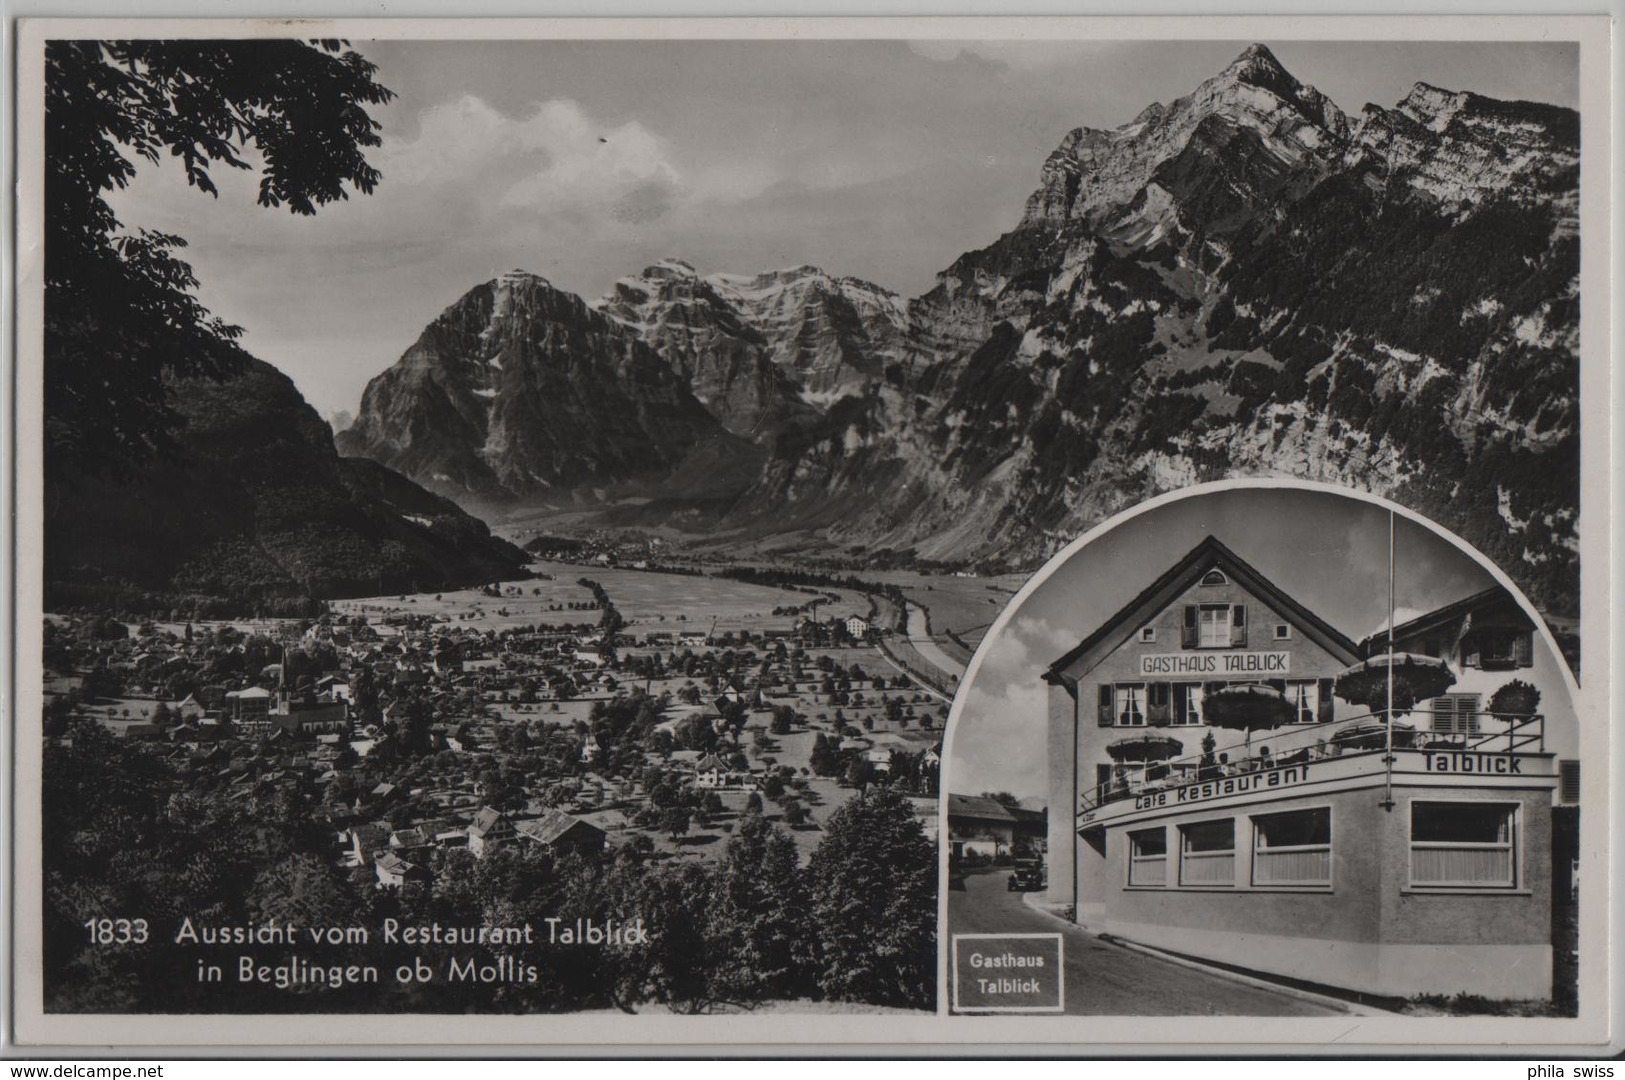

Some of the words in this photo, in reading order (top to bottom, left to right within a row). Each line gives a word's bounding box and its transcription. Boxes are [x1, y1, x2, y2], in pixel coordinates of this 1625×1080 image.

[1143, 656, 1216, 672] GASTHAUS
[1223, 654, 1286, 671] TALBLICK
[1423, 752, 1521, 773] Talblick
[1177, 766, 1309, 802] Restaurant
